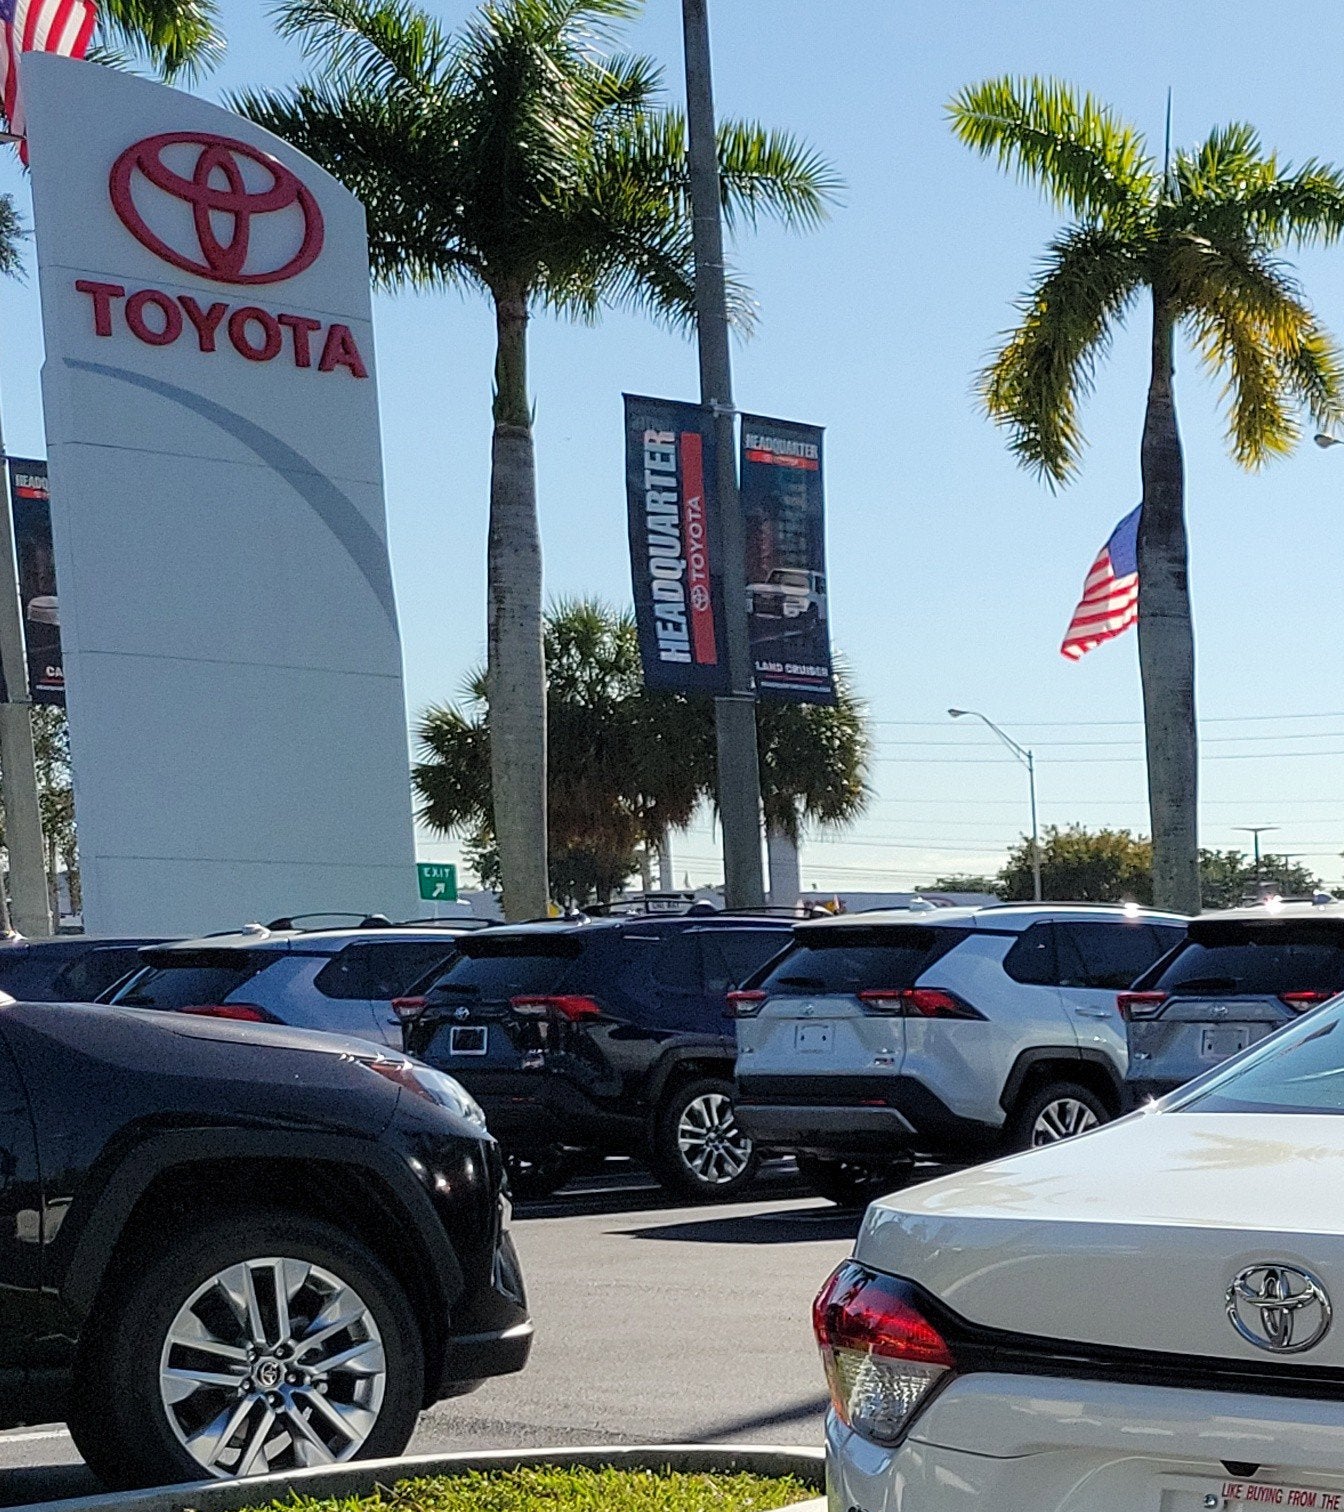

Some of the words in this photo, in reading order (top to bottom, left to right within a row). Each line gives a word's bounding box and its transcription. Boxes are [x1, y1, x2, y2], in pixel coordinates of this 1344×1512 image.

[75, 279, 369, 379] TOYOTA
[643, 429, 692, 664] HEADQUARTER
[688, 496, 707, 581] TOYOTA
[755, 660, 784, 673] LAND
[424, 867, 450, 878] EXIT
[1222, 1482, 1242, 1499] LIKE
[1246, 1484, 1283, 1504] BUYING
[1287, 1490, 1317, 1507] FROM
[1321, 1493, 1341, 1510] THE
